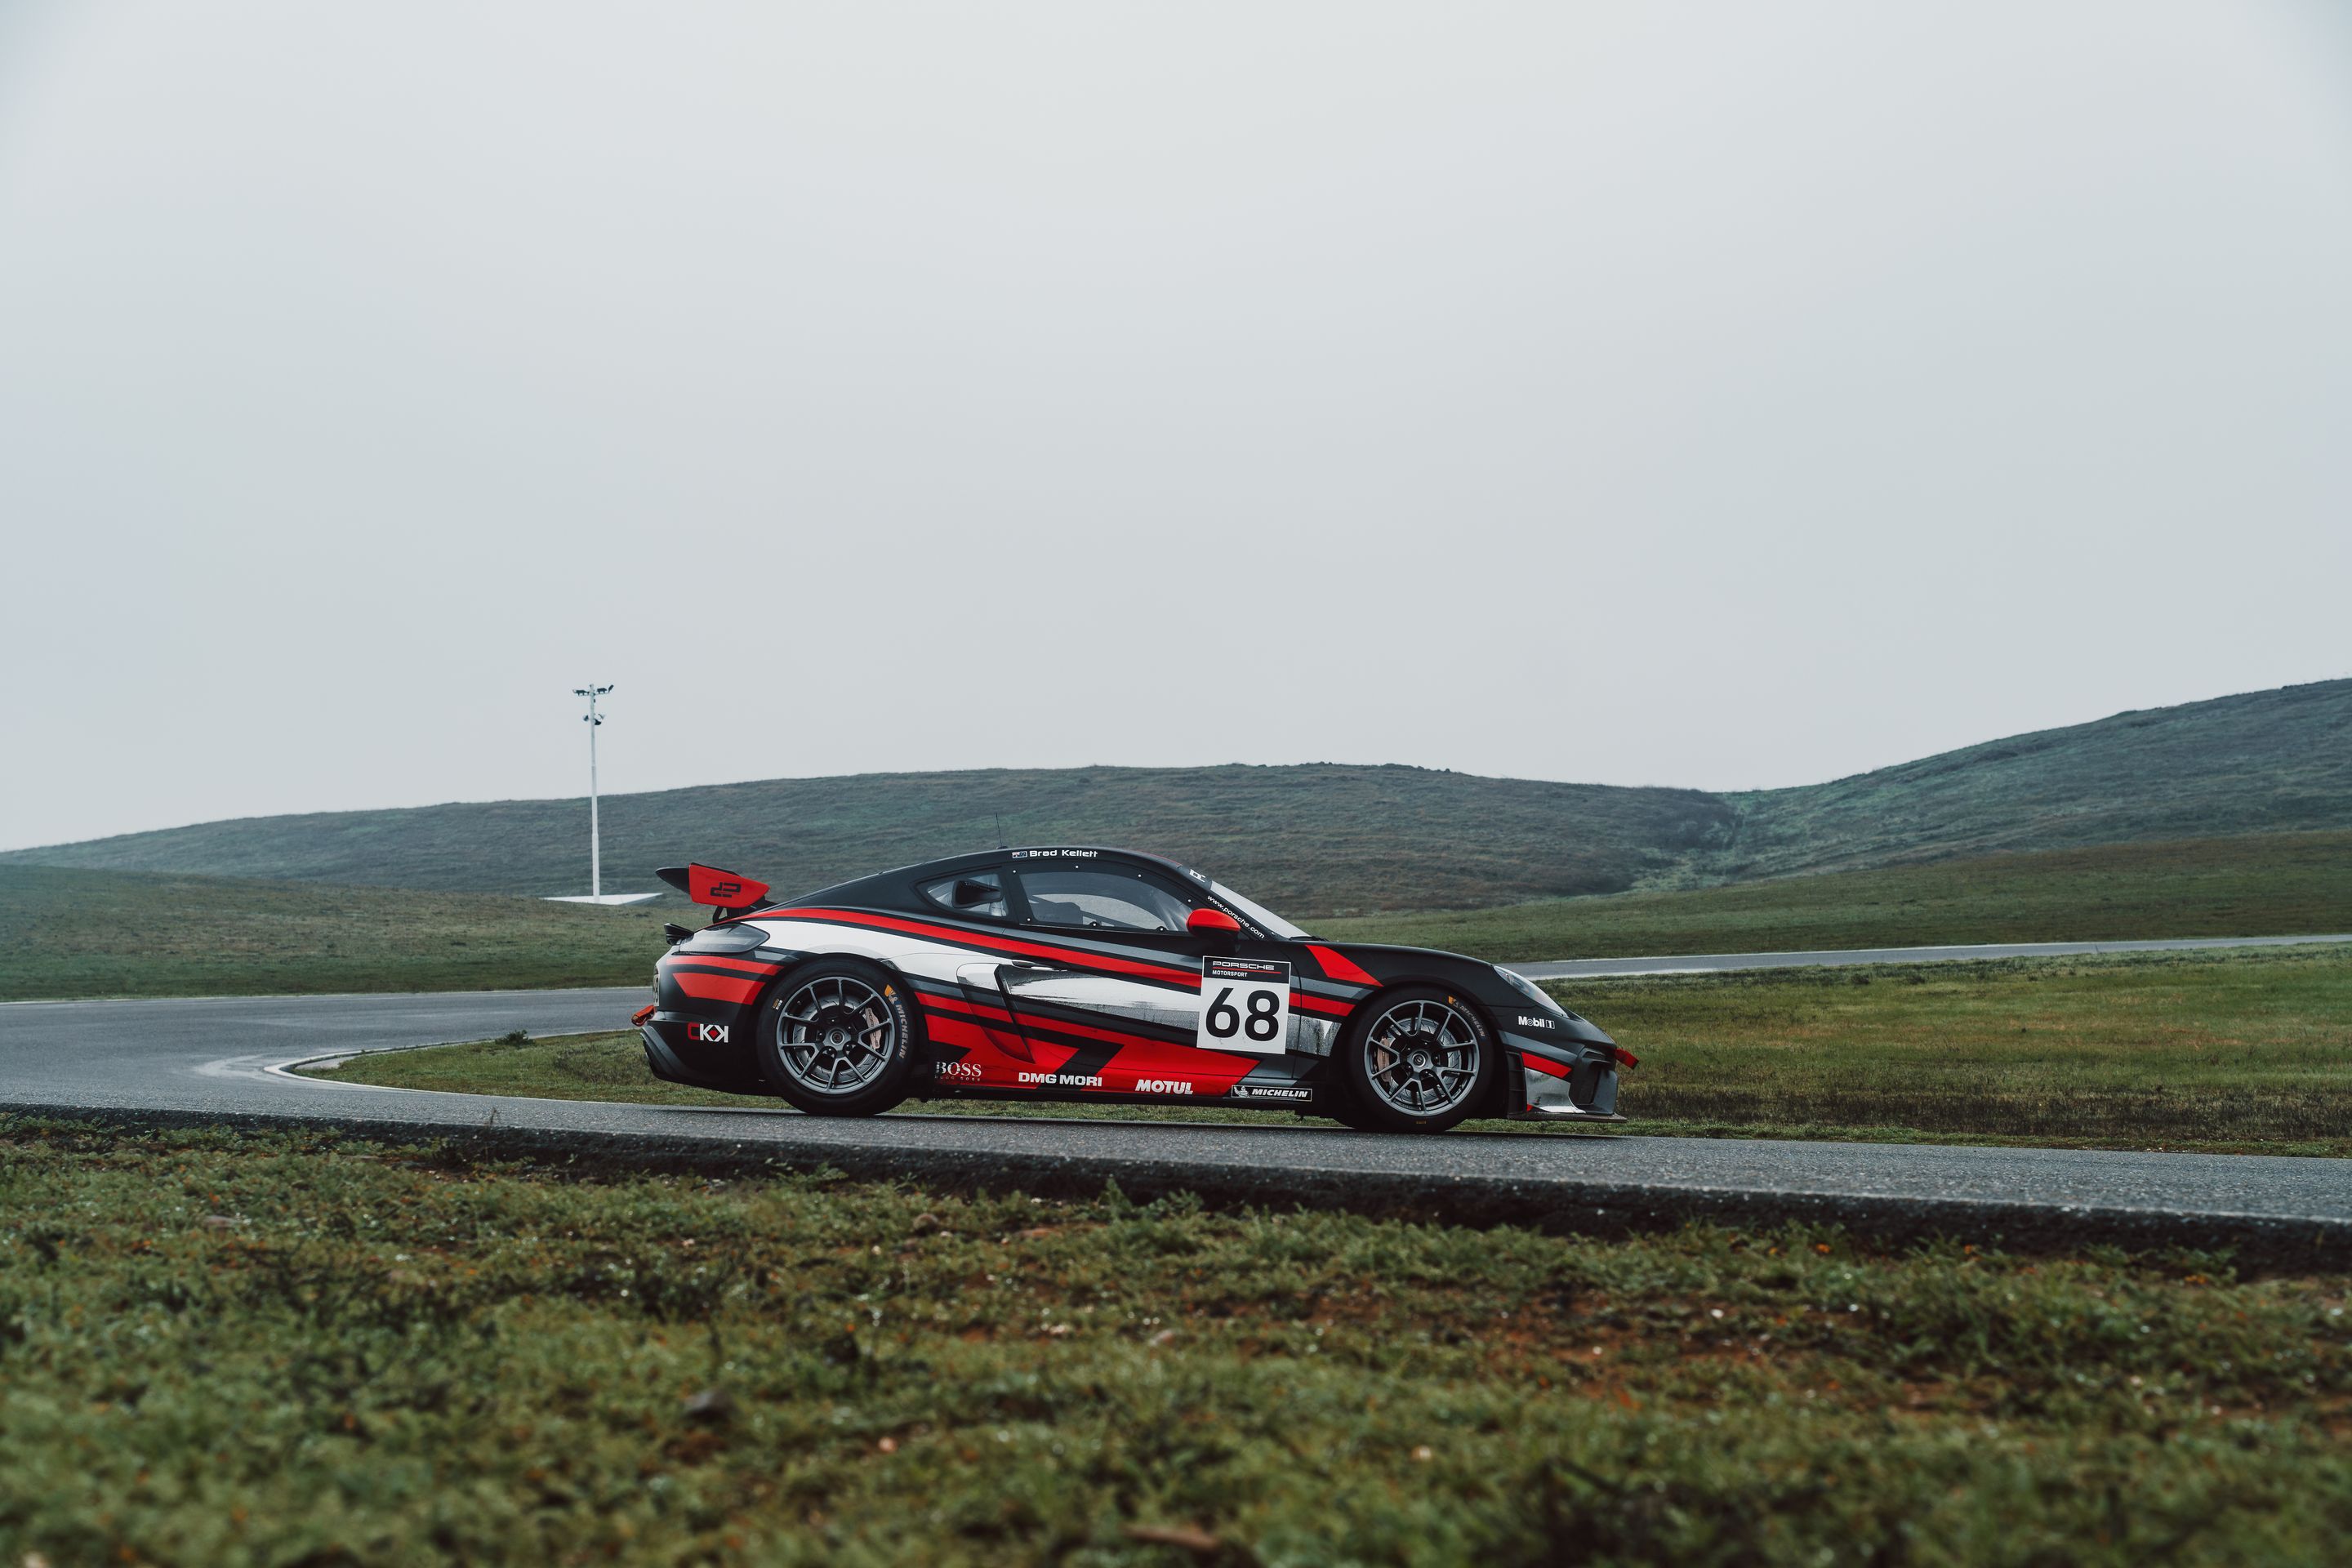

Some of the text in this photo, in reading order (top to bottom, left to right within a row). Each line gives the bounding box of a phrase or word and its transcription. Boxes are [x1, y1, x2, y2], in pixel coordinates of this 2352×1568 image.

[1208, 895, 1265, 939] www.porsche.com
[1213, 960, 1274, 971] PORSCHE
[1205, 987, 1280, 1042] 68
[1518, 1016, 1545, 1028] Mobil
[895, 1004, 908, 1059] MICHELIN
[936, 1062, 982, 1077] BOSS
[1018, 1072, 1102, 1087] DMG MORI
[1135, 1079, 1194, 1095] MOTUL
[1251, 1089, 1308, 1098] MICHELIN
